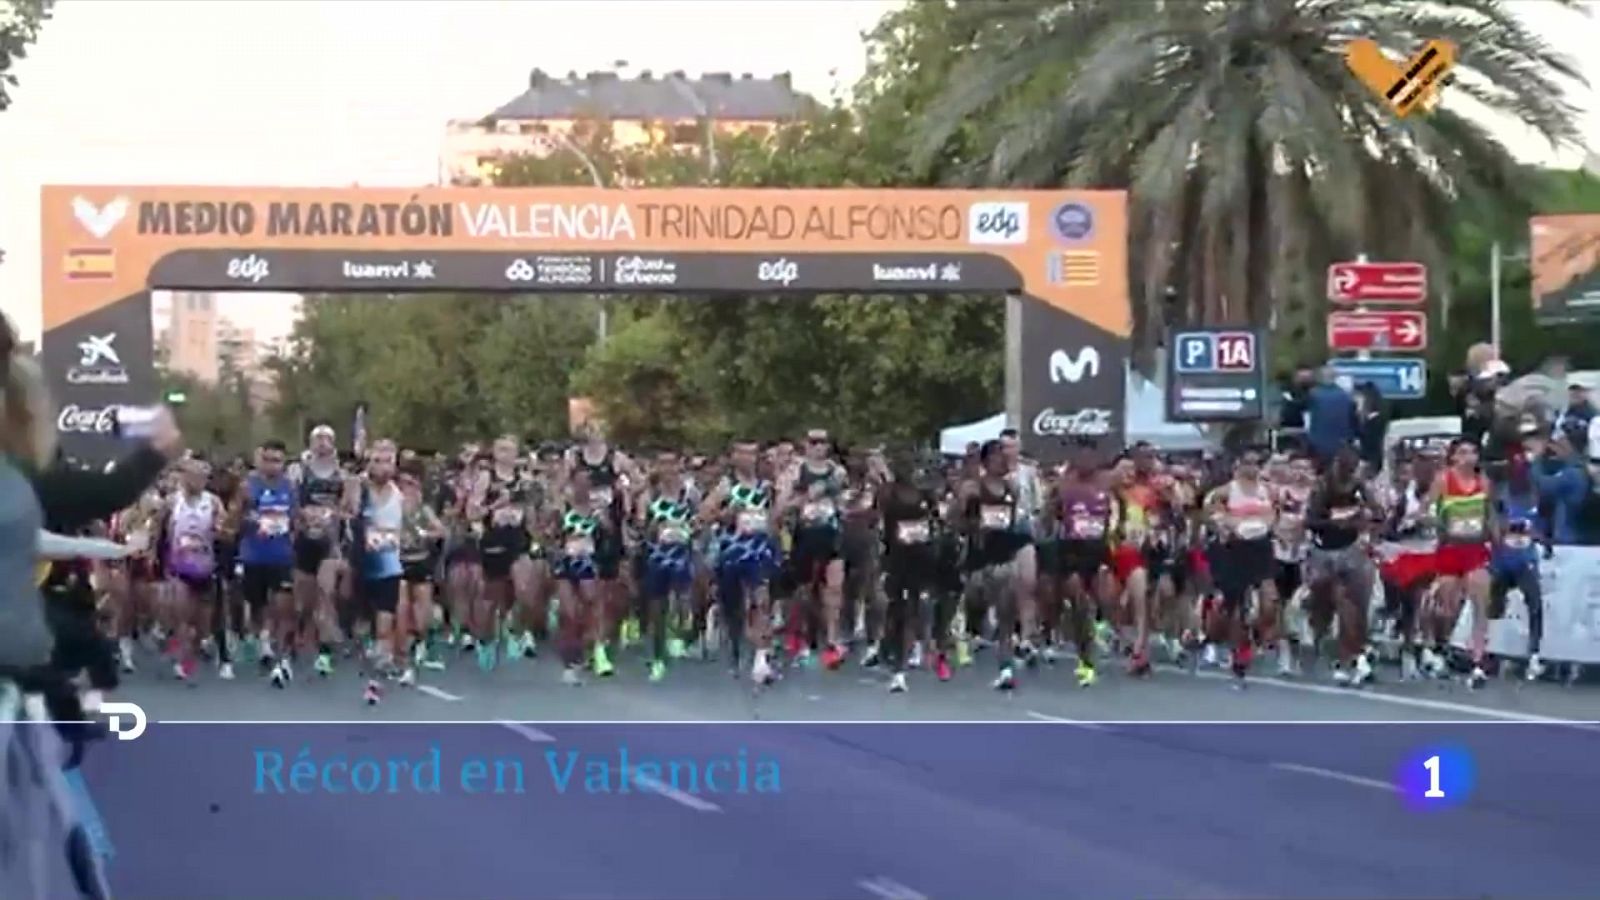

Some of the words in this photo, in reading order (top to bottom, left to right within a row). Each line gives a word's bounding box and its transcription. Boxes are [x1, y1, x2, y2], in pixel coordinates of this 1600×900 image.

[136, 200, 255, 236] MEDIO
[266, 194, 454, 237] MARATÓN
[459, 202, 636, 241] VALENCIA
[637, 203, 795, 240] TRINIDAD
[801, 204, 962, 241] ALFONSO
[975, 205, 1021, 238] edp
[226, 253, 270, 283] edp
[757, 258, 800, 286] edp
[1187, 340, 1205, 365] P
[1219, 340, 1250, 365] 1A
